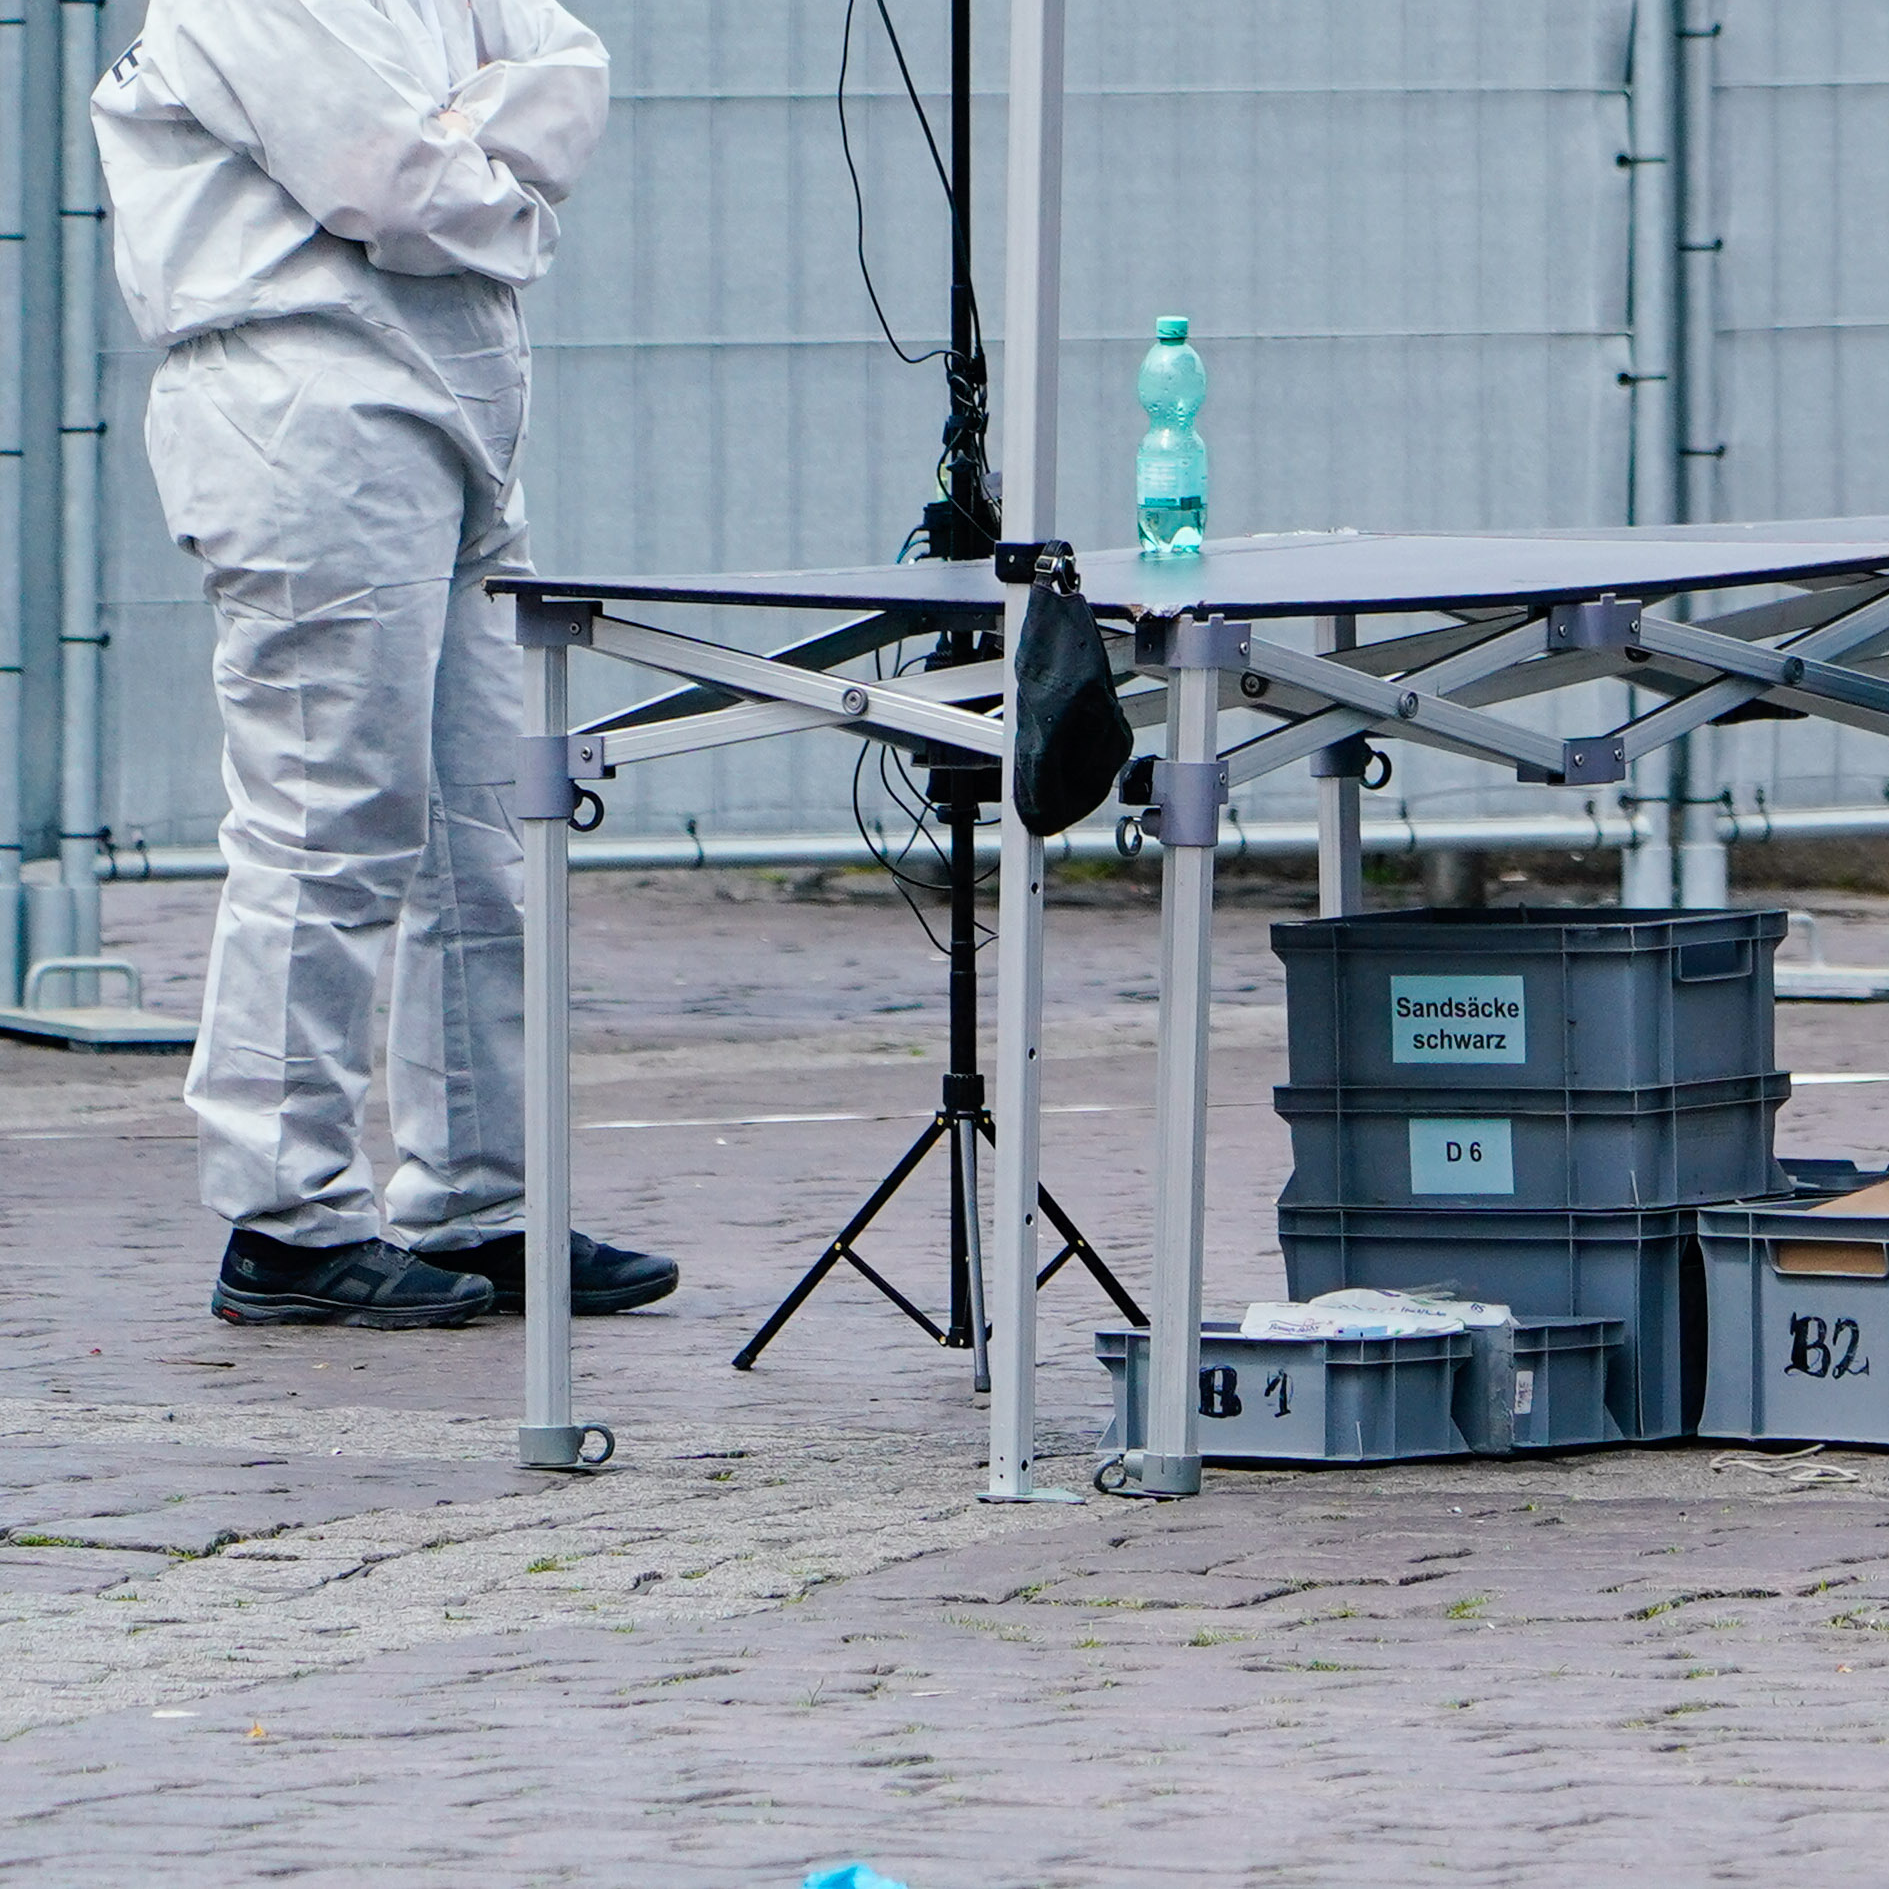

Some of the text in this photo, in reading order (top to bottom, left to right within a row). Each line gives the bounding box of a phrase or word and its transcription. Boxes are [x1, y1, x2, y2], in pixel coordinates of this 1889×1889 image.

[1396, 995, 1520, 1021] Sandsäcke
[1413, 1027, 1507, 1051] schwarz
[1446, 1141, 1482, 1164] D 6
[1784, 1311, 1869, 1380] B2
